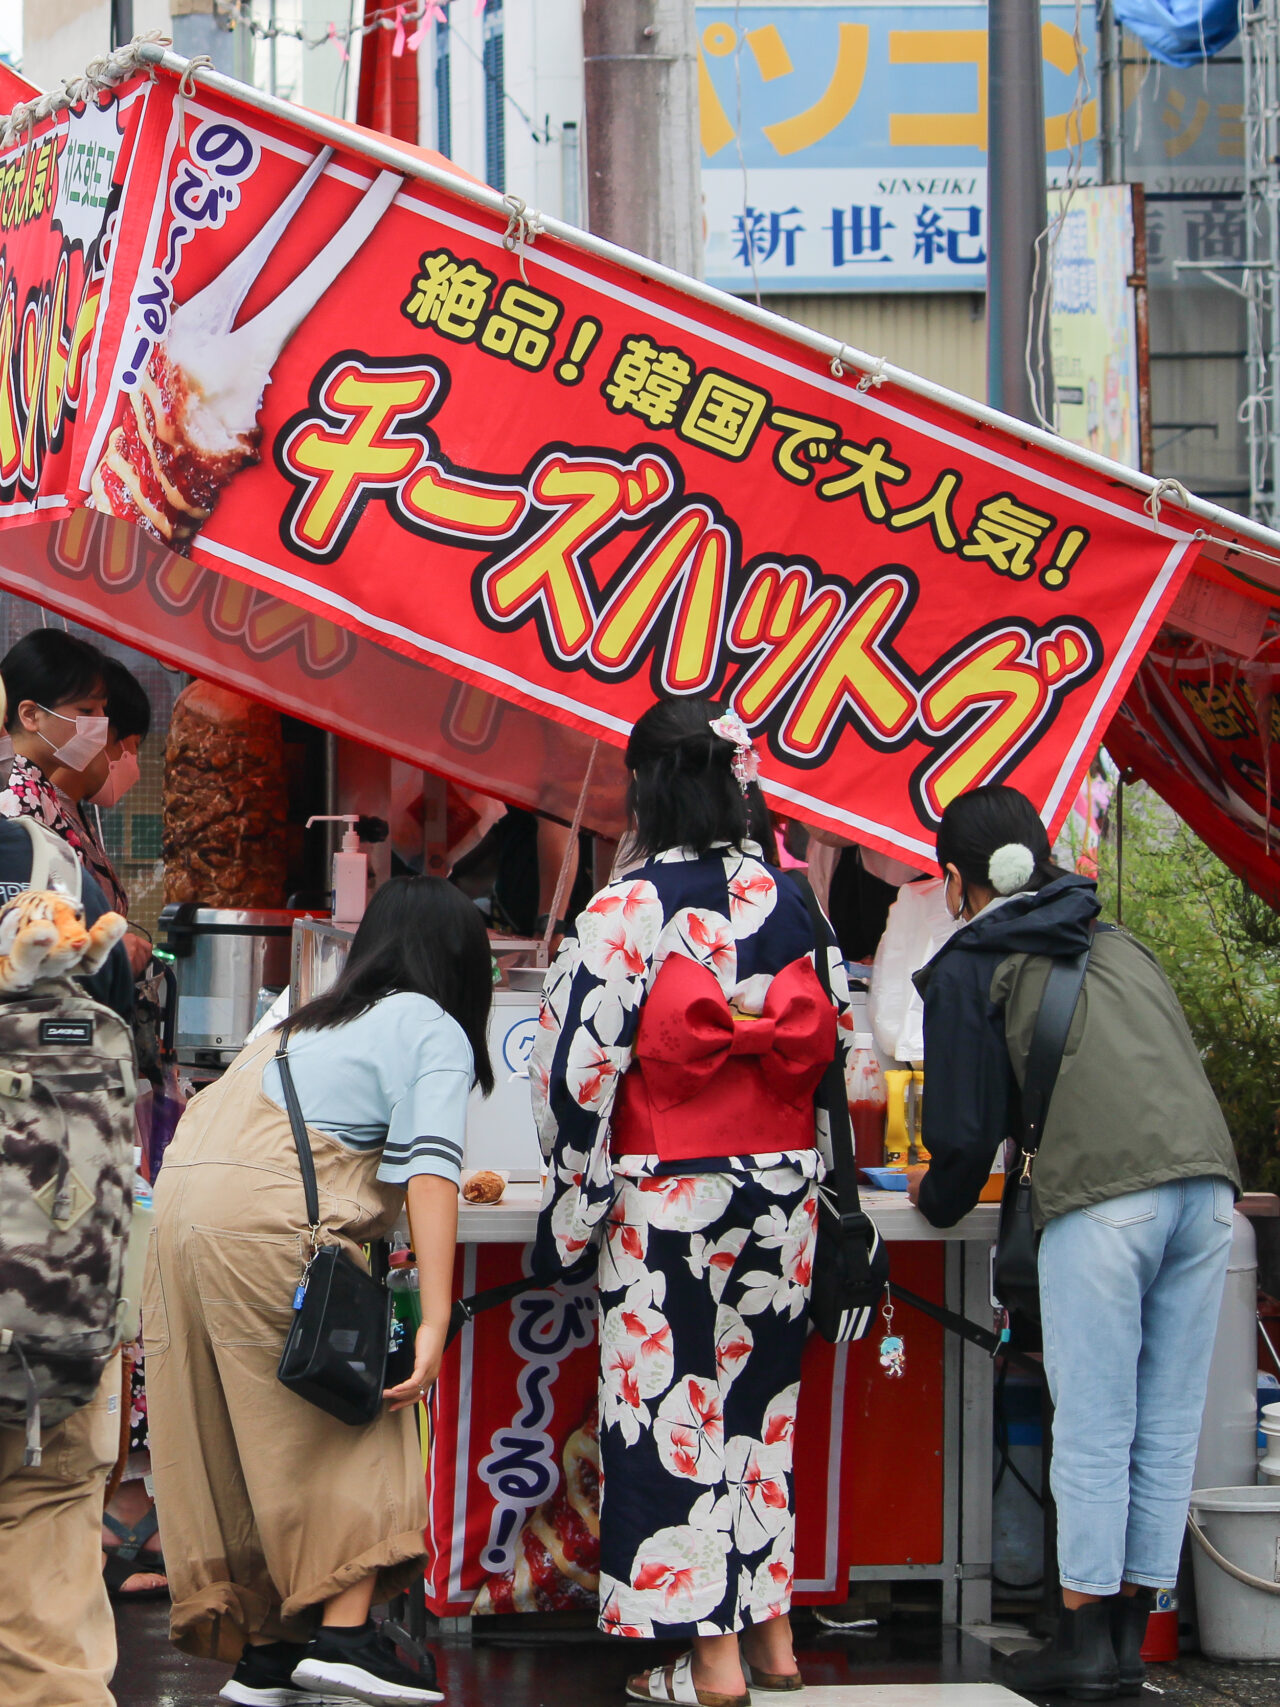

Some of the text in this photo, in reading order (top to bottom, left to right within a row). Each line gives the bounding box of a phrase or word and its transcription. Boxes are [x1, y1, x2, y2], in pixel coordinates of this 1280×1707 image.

[877, 178, 977, 195] SINSEIKI
[731, 203, 988, 267] 新世紀
[277, 352, 1100, 828] チーズハットグ
